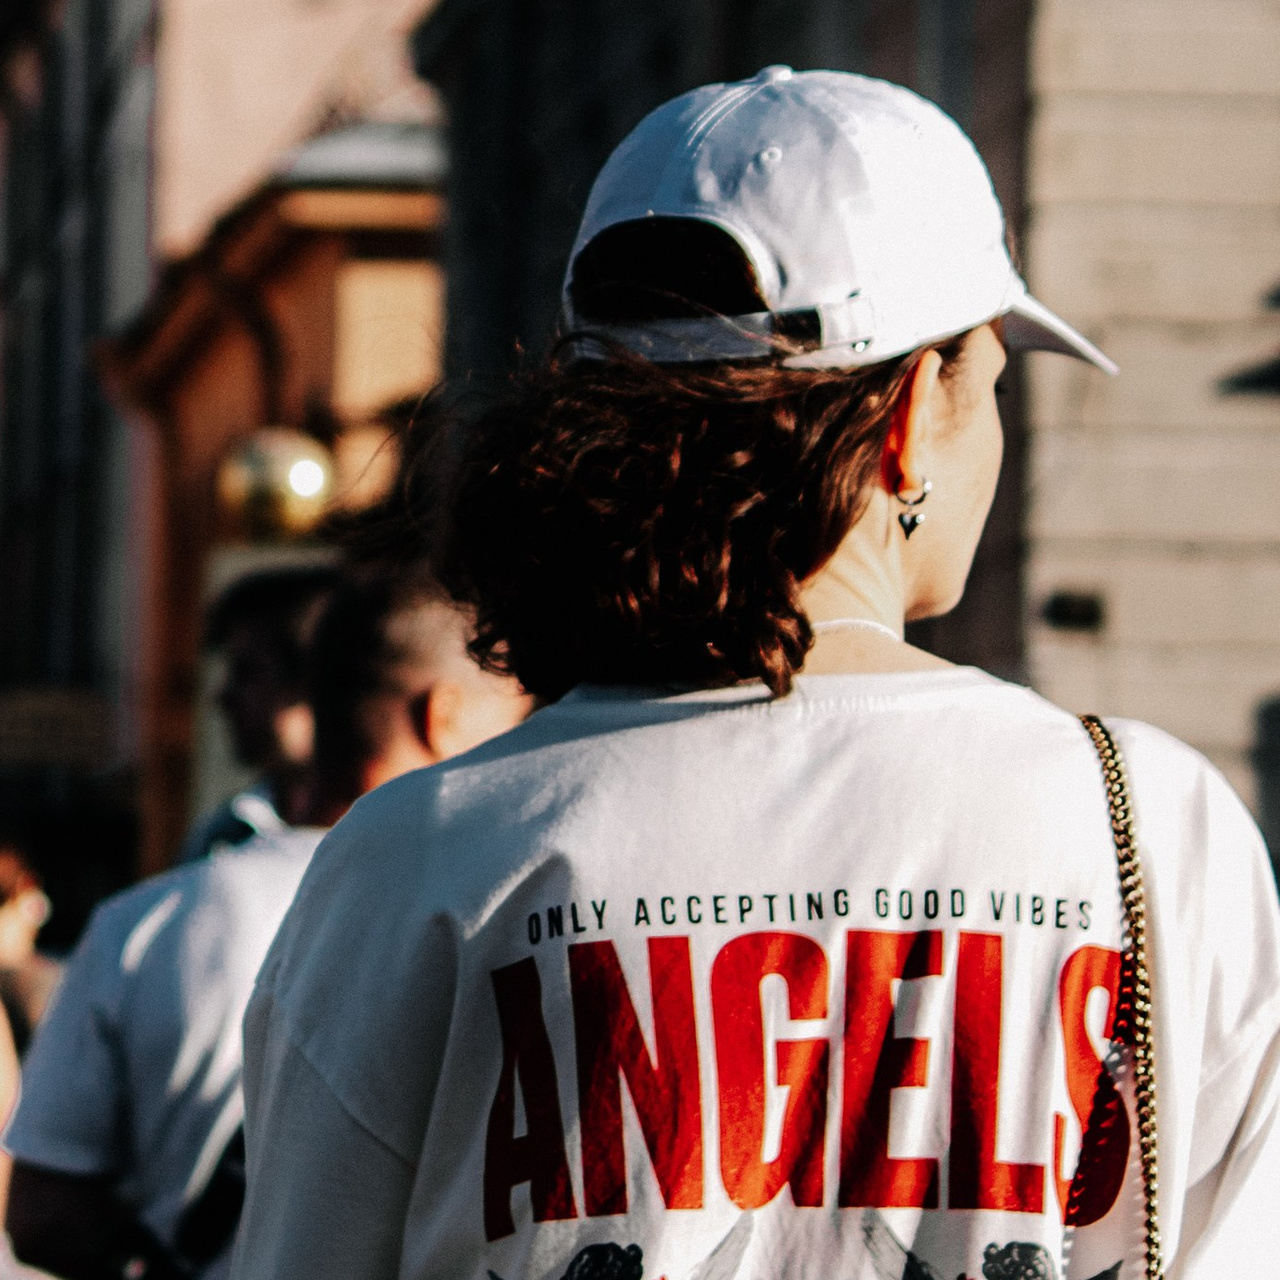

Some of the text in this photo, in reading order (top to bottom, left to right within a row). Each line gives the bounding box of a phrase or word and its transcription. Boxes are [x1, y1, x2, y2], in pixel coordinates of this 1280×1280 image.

[526, 888, 1094, 946] ONLY ACCEPTING GOOD VIBES
[483, 929, 1131, 1243] ANGELS
